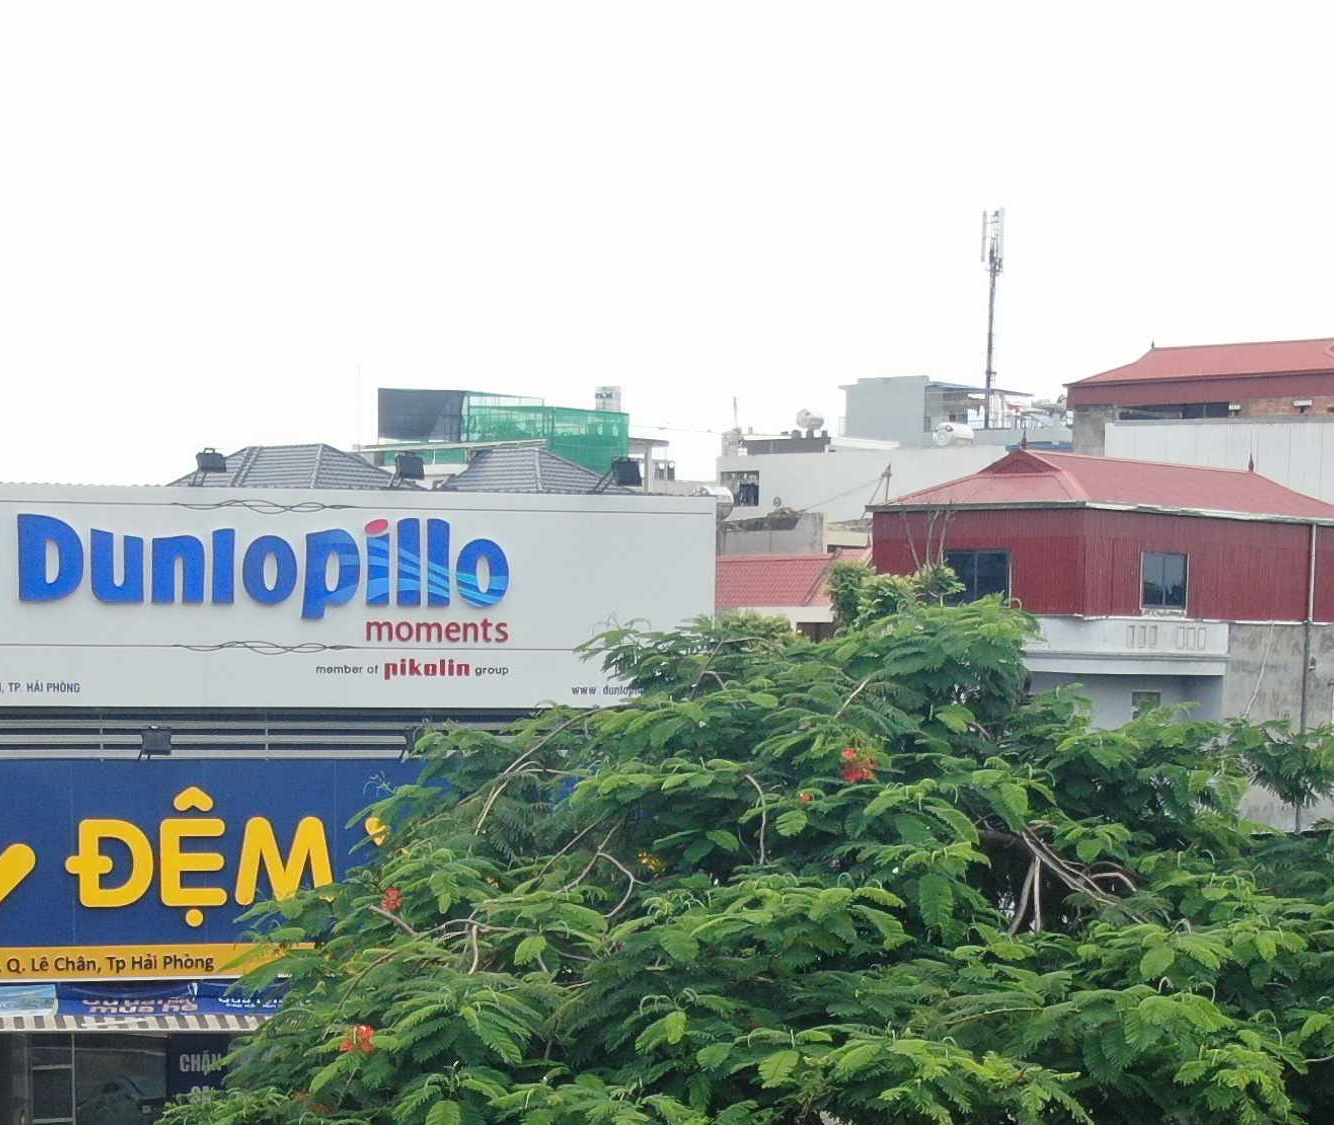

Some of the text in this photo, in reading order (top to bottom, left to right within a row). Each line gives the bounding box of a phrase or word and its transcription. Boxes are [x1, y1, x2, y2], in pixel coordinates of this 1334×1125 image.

[17, 513, 509, 619] Dunlopillo
[366, 618, 510, 644] moments
[315, 659, 510, 681] member of pikolin group
[65, 786, 334, 927] ĐỆM
[7, 957, 26, 975] Q.
[31, 956, 49, 972] Lê
[54, 956, 102, 973] Chân,
[106, 956, 126, 974] Tp
[131, 953, 157, 970] Hải
[162, 953, 215, 972] Phòng
